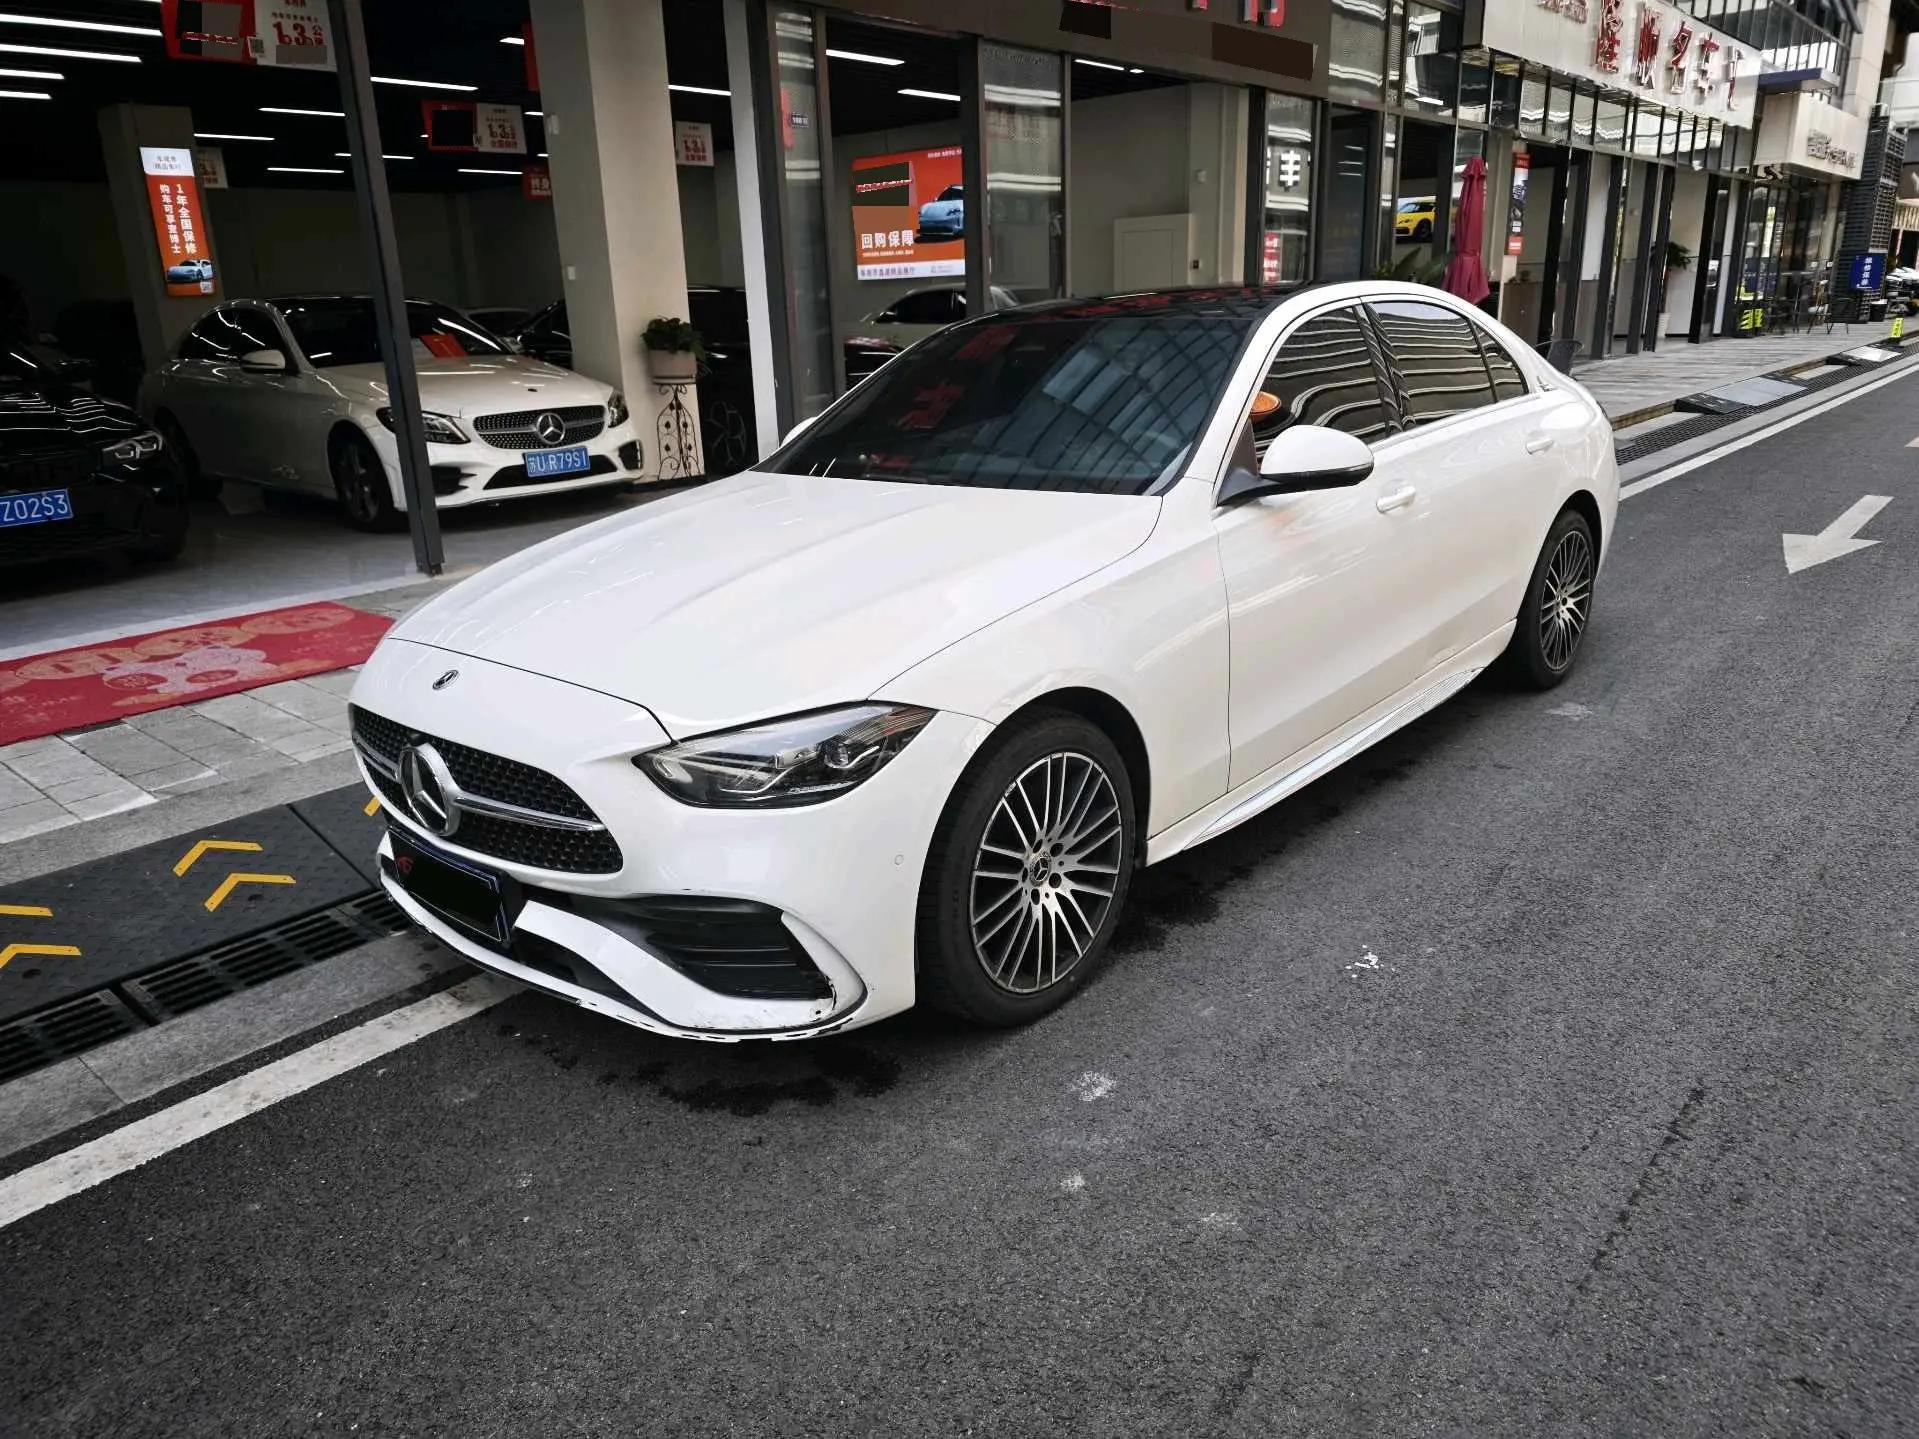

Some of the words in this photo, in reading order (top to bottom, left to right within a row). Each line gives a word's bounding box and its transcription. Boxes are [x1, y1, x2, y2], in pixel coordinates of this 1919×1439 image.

[176, 183, 197, 254] 1年全国保修
[861, 229, 914, 249] 回购保障
